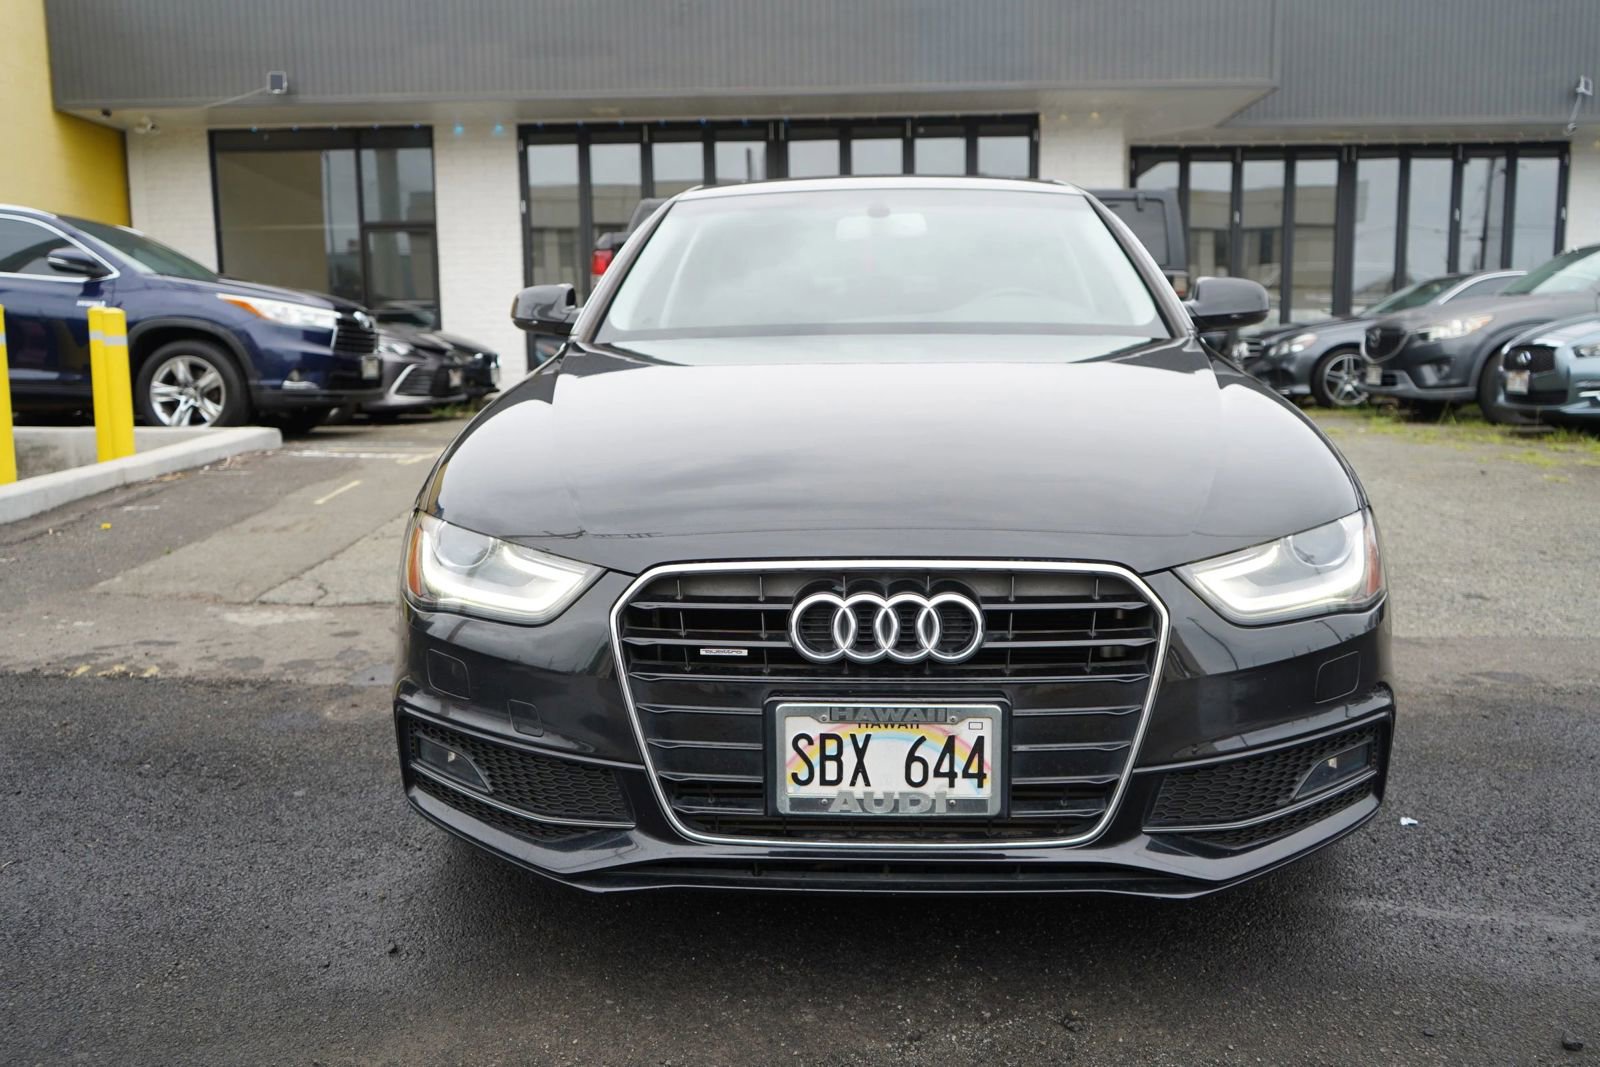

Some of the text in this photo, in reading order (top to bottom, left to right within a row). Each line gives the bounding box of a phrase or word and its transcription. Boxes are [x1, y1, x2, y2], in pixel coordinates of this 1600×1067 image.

[831, 707, 947, 722] HAWAII
[791, 733, 987, 788] SBX 644
[827, 791, 947, 814] AUDI
